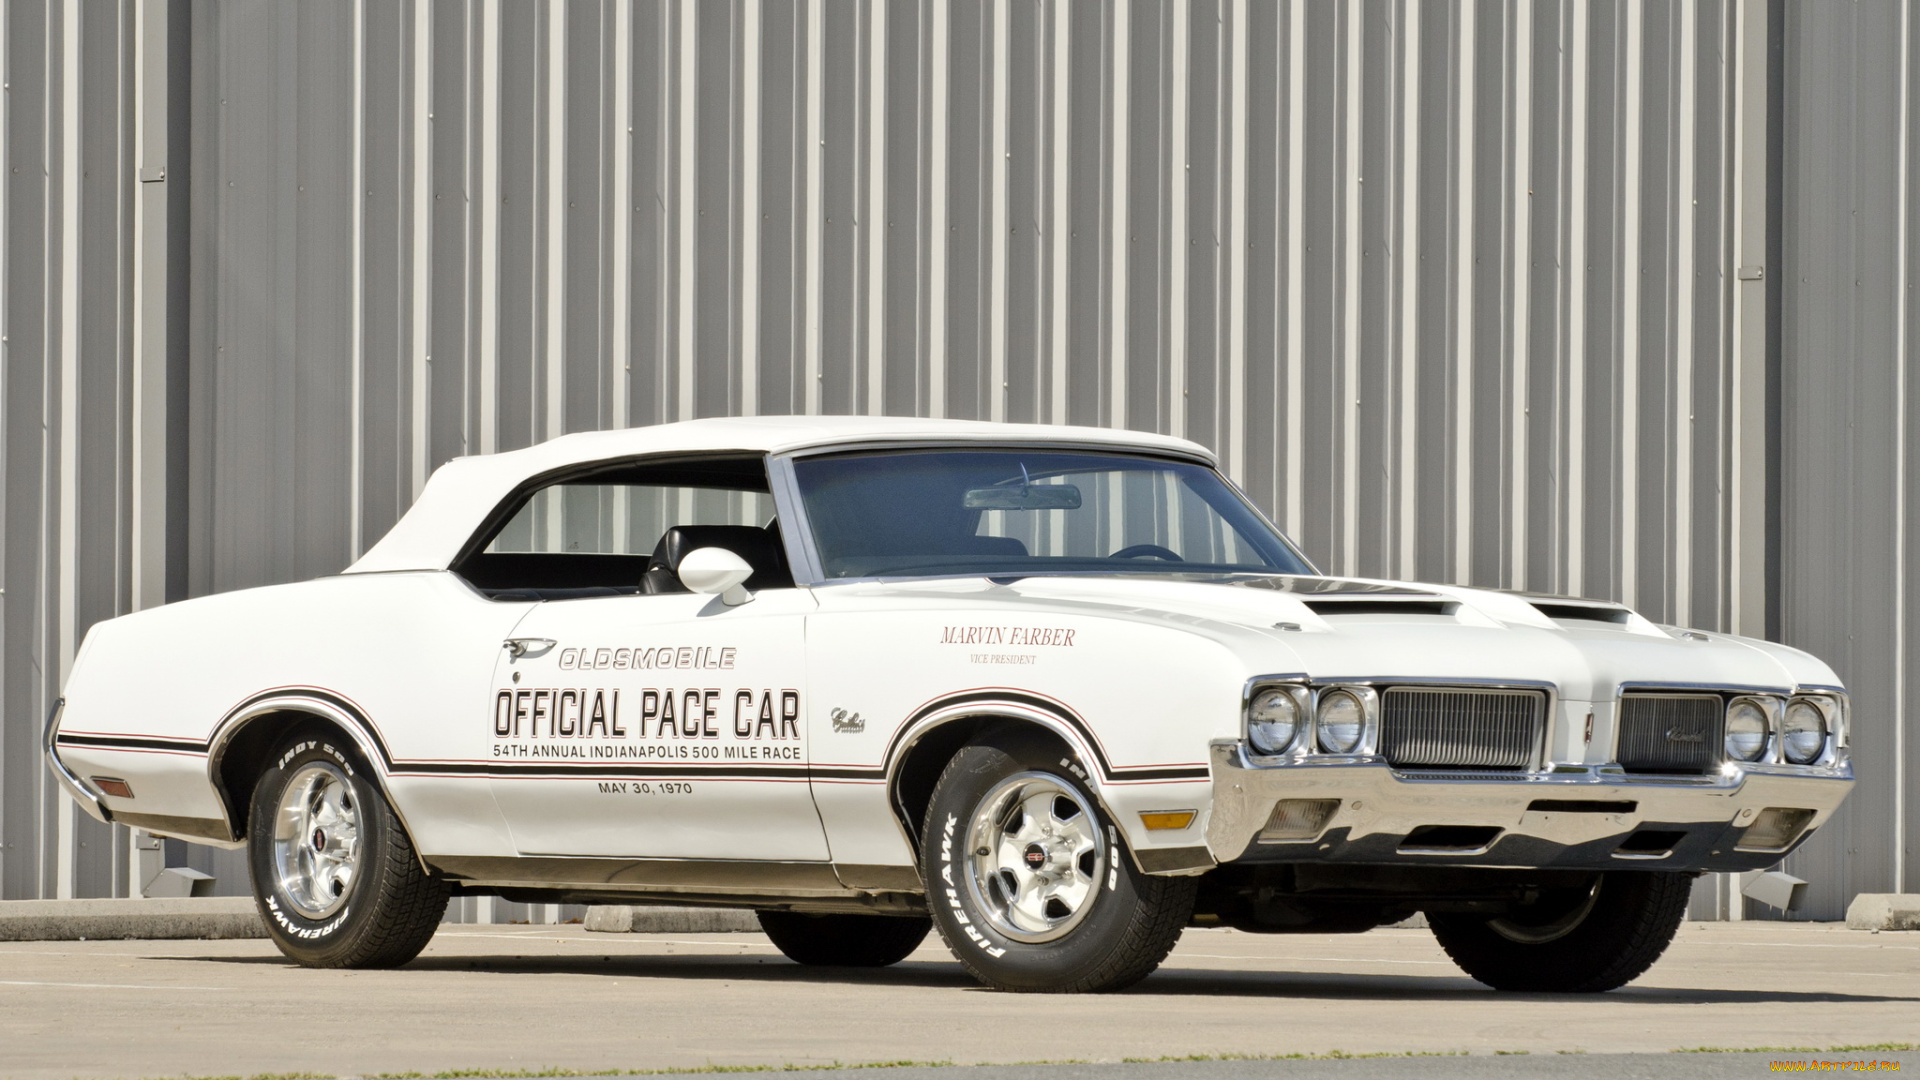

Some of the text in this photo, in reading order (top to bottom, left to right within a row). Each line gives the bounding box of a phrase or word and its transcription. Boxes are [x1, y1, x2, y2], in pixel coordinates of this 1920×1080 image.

[940, 626, 1076, 647] MARVIN FARBER
[558, 647, 737, 670] OLDSMOBILE
[970, 653, 1037, 665] VICE PRESIDENT
[494, 688, 801, 740] OFFICIAL PACE CAR
[278, 741, 354, 776] INDY 500
[493, 744, 801, 760] 54TH ANNUAL INDIANAPOLIS 500 MILE RACE
[598, 782, 693, 796] MAY 30, 1970
[940, 812, 1006, 958] FIREHAWK
[265, 895, 350, 939] FIREHAWK
